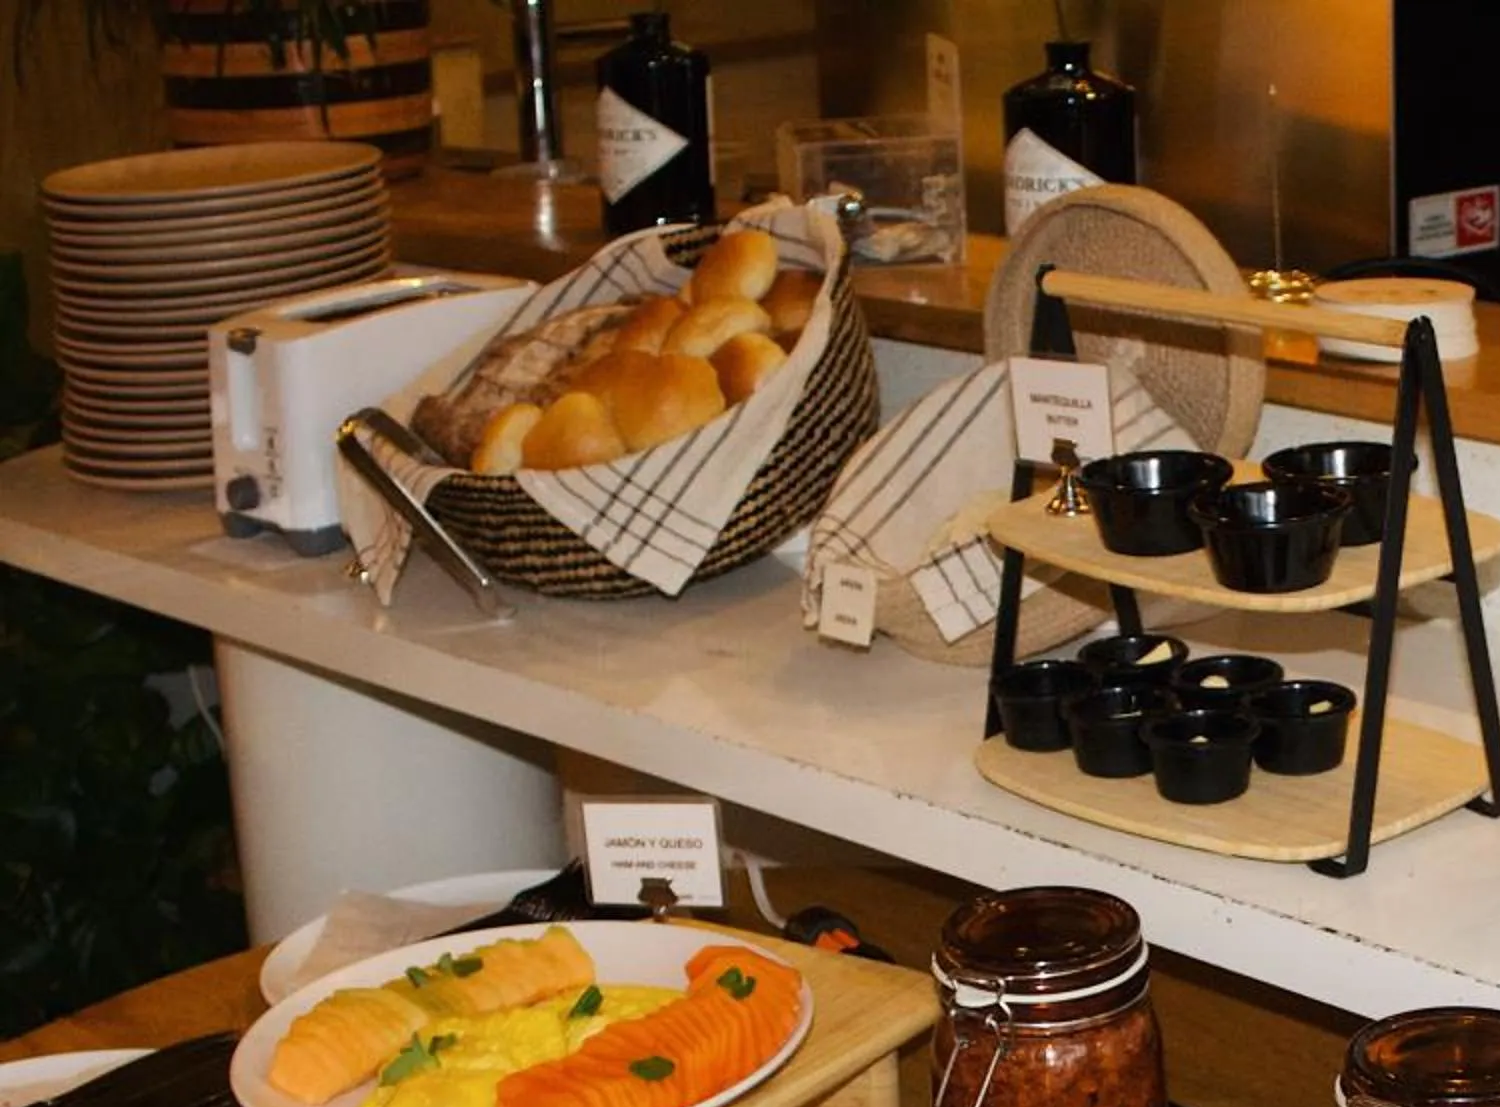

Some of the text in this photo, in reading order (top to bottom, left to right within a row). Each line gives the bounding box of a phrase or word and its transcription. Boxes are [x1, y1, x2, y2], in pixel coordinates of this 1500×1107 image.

[1029, 392, 1092, 409] MANTEQUILLA
[604, 836, 703, 849] JAMÓN Y QUESO
[657, 860, 697, 870] CHEESE
